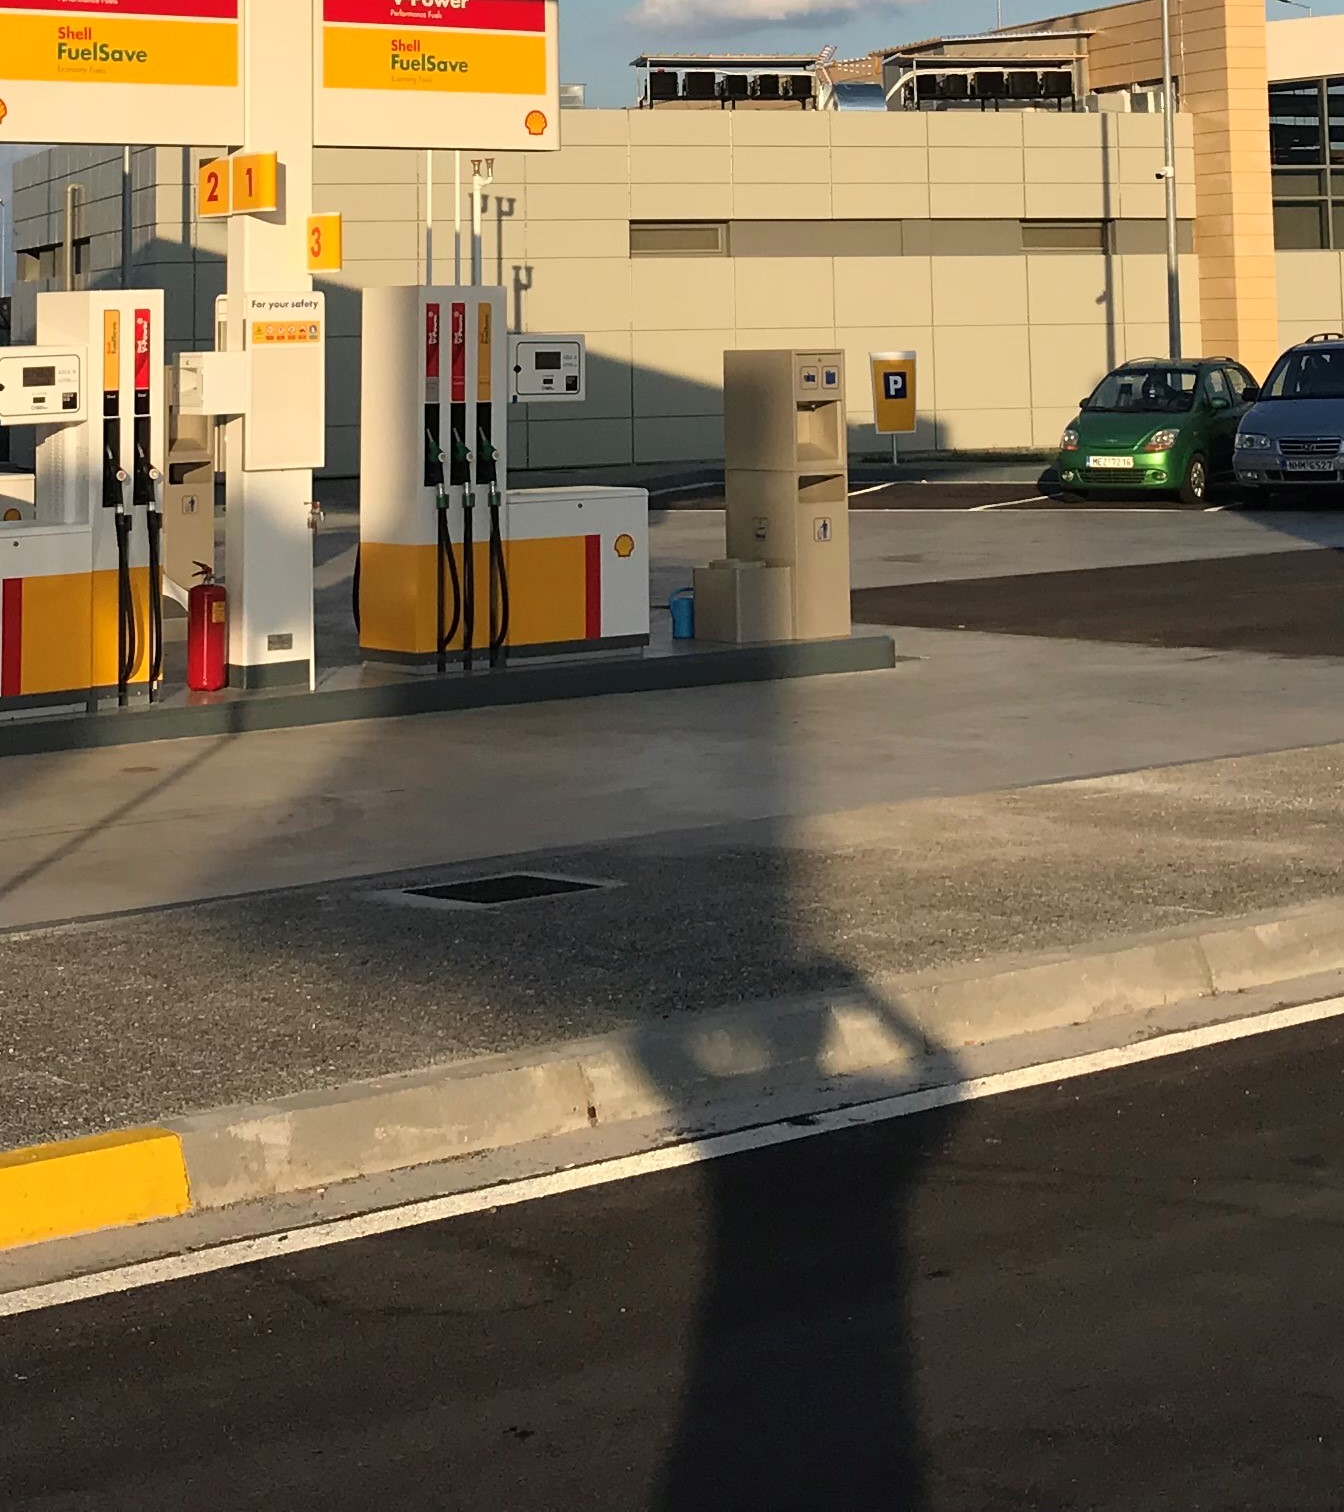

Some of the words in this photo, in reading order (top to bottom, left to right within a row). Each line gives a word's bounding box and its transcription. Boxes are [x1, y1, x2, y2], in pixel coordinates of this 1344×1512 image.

[58, 26, 92, 40] Shell
[57, 42, 148, 63] FuelSave
[391, 39, 421, 52] Shell
[391, 53, 469, 73] FuelSave
[207, 171, 219, 202] 2
[245, 167, 253, 197] 1
[310, 226, 322, 258] 3
[251, 300, 266, 308] For
[268, 301, 289, 311] your
[291, 299, 319, 310] safety
[889, 375, 903, 396] P
